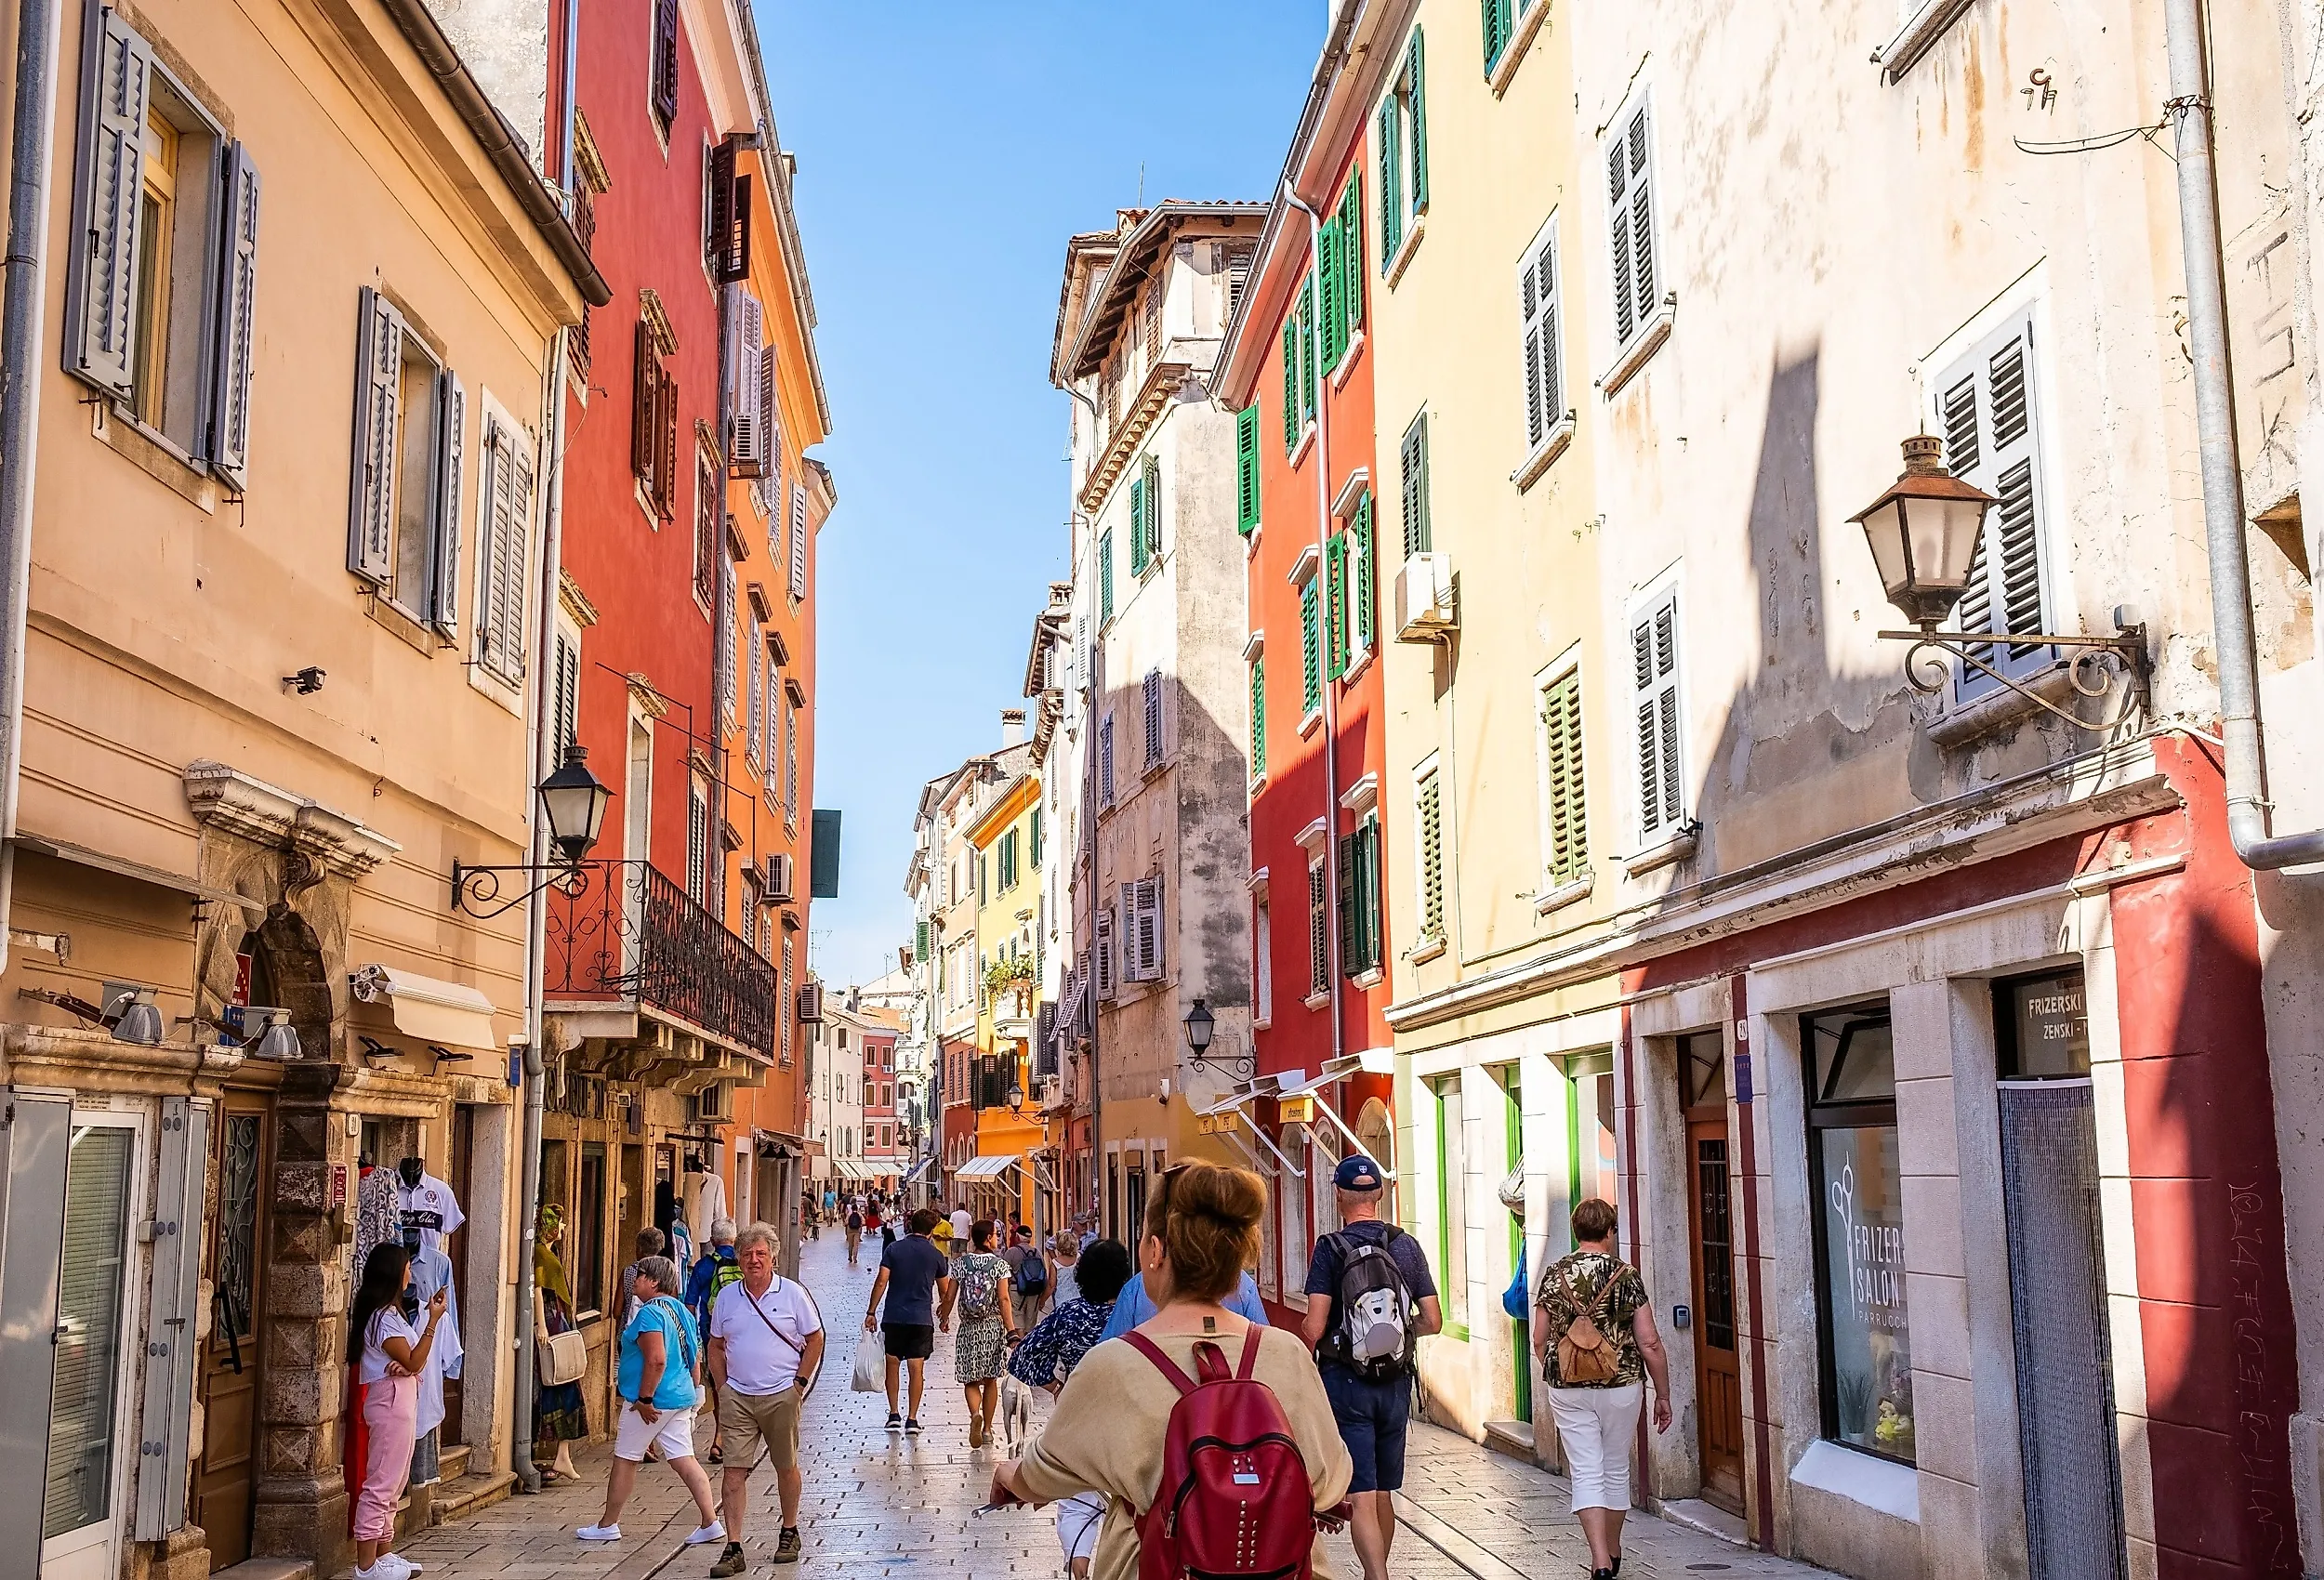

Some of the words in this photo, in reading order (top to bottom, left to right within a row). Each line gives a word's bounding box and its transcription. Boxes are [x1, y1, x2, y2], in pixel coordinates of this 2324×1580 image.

[2028, 993, 2081, 1019] FRIZERSKI
[2043, 1021, 2074, 1040] ŽENSKI
[1855, 1225, 1905, 1265] FRIZER
[1856, 1267, 1900, 1309] SALON
[1858, 1310, 1907, 1330] PARRUCCH
